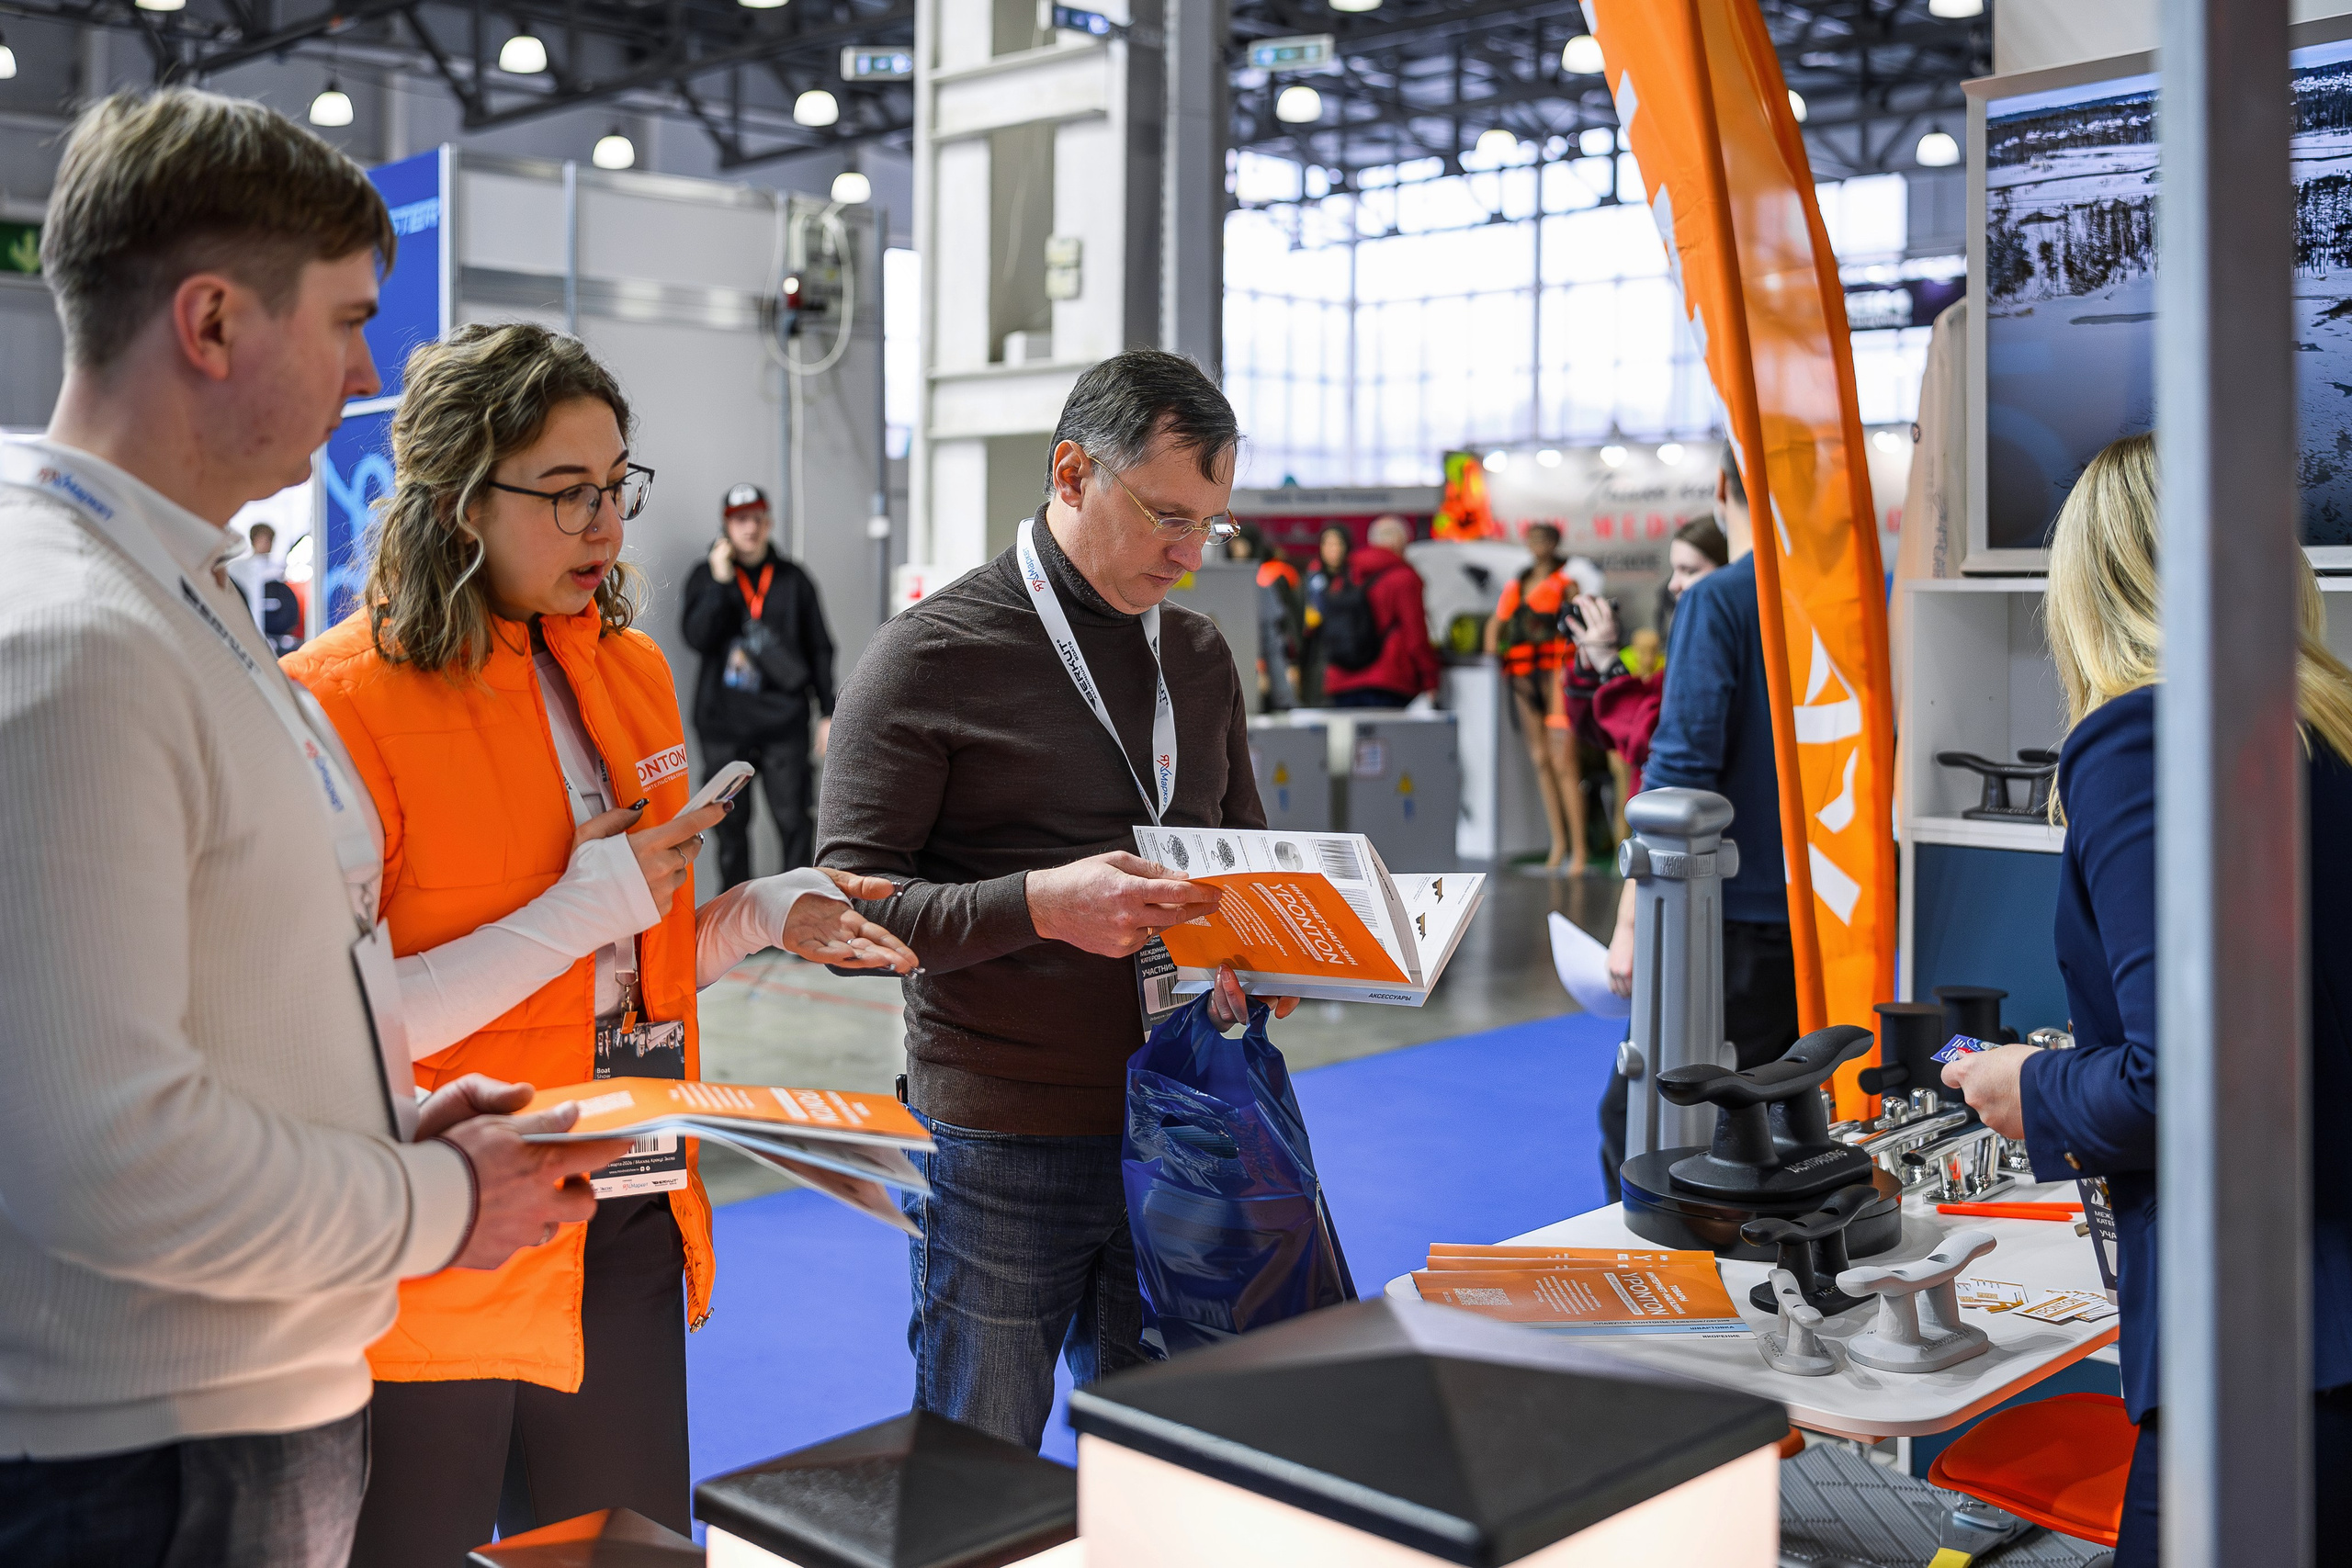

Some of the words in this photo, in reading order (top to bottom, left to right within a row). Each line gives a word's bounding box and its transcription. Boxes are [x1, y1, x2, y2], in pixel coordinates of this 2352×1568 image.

[1067, 641, 1080, 660] BOATS
[1058, 642, 1097, 712] BERKUT
[1270, 884, 1344, 964] YPONTON
[1288, 884, 1358, 965] ИНТЕРНЕТ-МАГАЗИН
[1140, 953, 1161, 964] КАТЕРОВ
[1142, 963, 1175, 977] УЧАСТНИК
[1368, 993, 1411, 1001] АКСЕССУАРЫ
[1621, 1272, 1669, 1315] YPONTON
[1645, 1271, 1686, 1314] ИНТЕРНЕТ-МАГАЗИН
[1668, 1284, 1689, 1302] ТОВАРЫ
